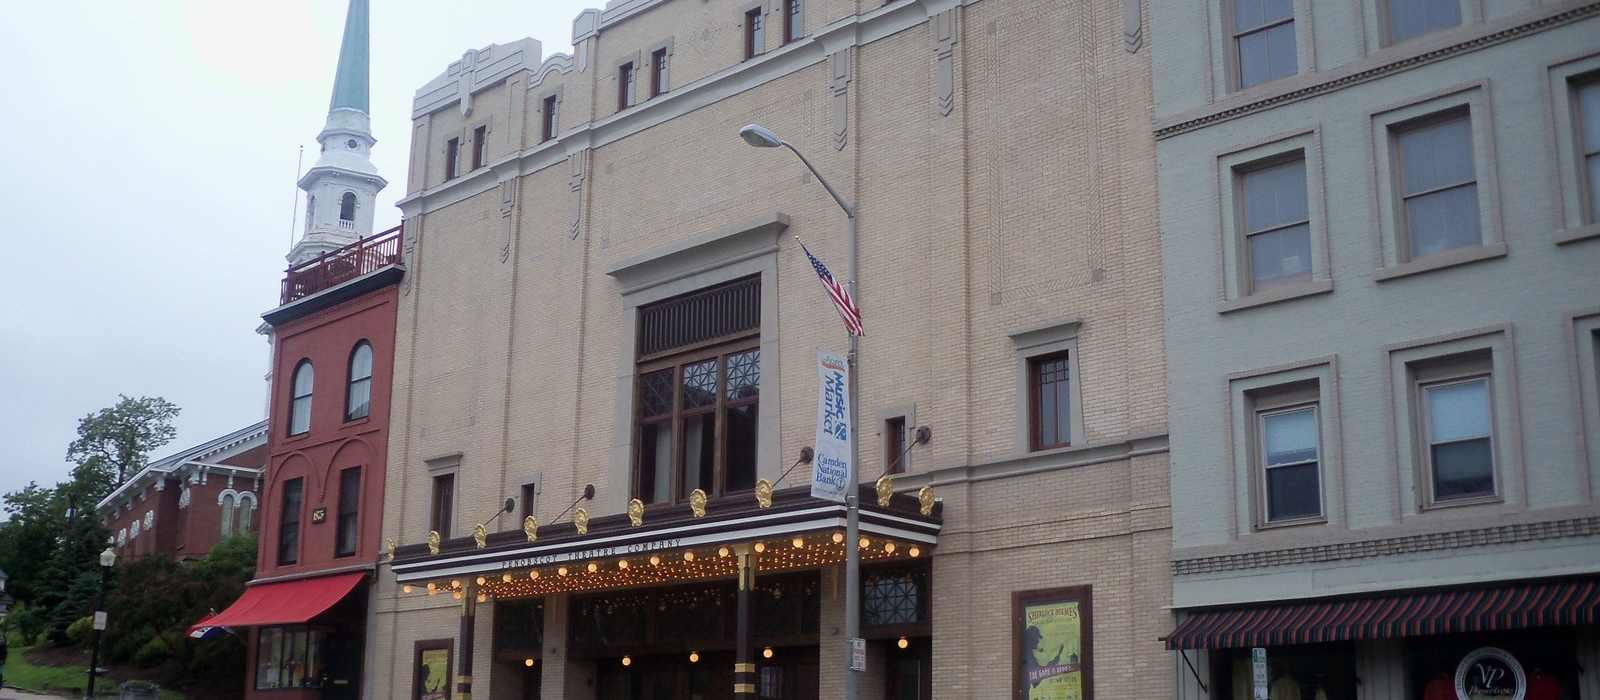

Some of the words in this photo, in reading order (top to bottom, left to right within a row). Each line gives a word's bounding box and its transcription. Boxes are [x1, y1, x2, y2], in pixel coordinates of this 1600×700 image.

[823, 374, 835, 435] Market
[832, 370, 845, 421] Music
[816, 462, 848, 480] National
[817, 453, 847, 469] Camden
[816, 472, 836, 486] Bank
[502, 555, 557, 568] PENOBSCOT
[568, 547, 616, 560] THEATRE
[628, 539, 681, 552] COMPANY
[1476, 663, 1505, 689] VP
